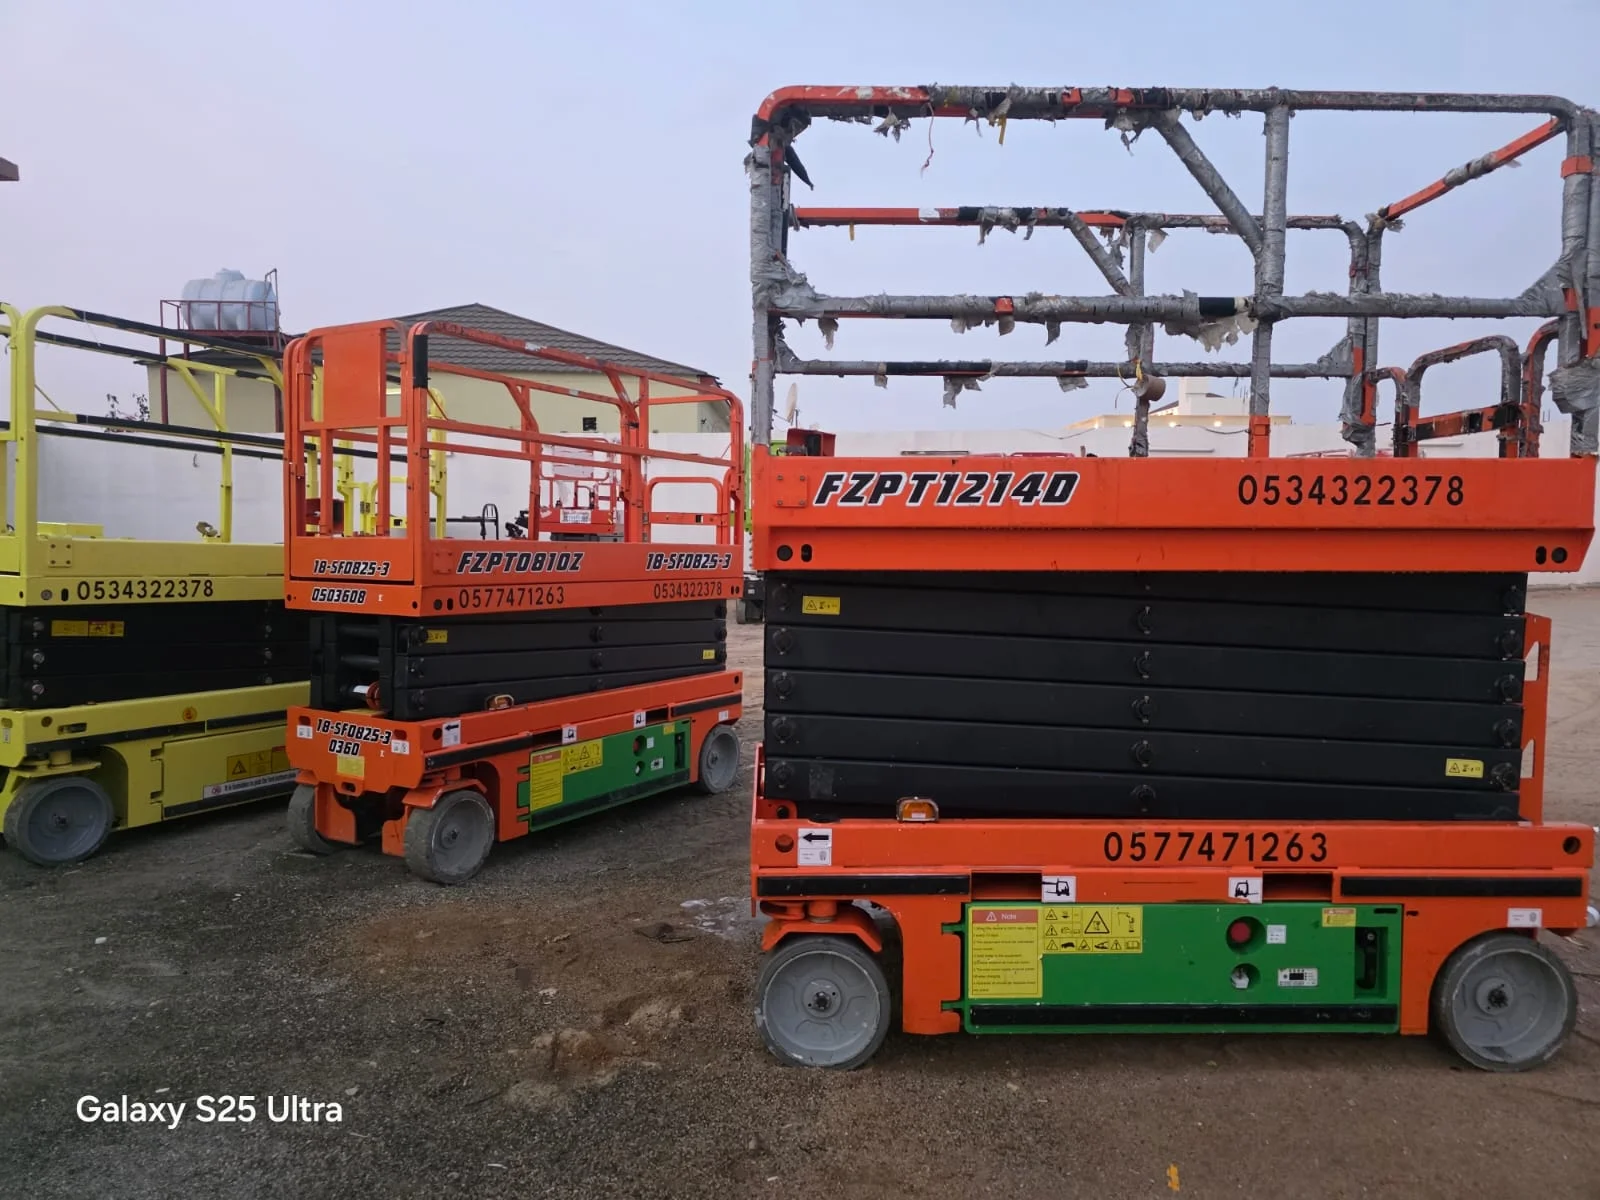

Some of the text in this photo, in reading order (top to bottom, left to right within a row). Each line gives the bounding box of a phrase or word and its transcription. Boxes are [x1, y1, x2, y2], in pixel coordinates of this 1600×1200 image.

[1238, 475, 1464, 506] 0534322378
[456, 552, 584, 574] FZPT0810Z
[77, 580, 214, 600] 0534322378
[459, 586, 564, 609] 0577471263
[653, 581, 723, 599] 0534322378
[1103, 831, 1329, 862] 0577471263
